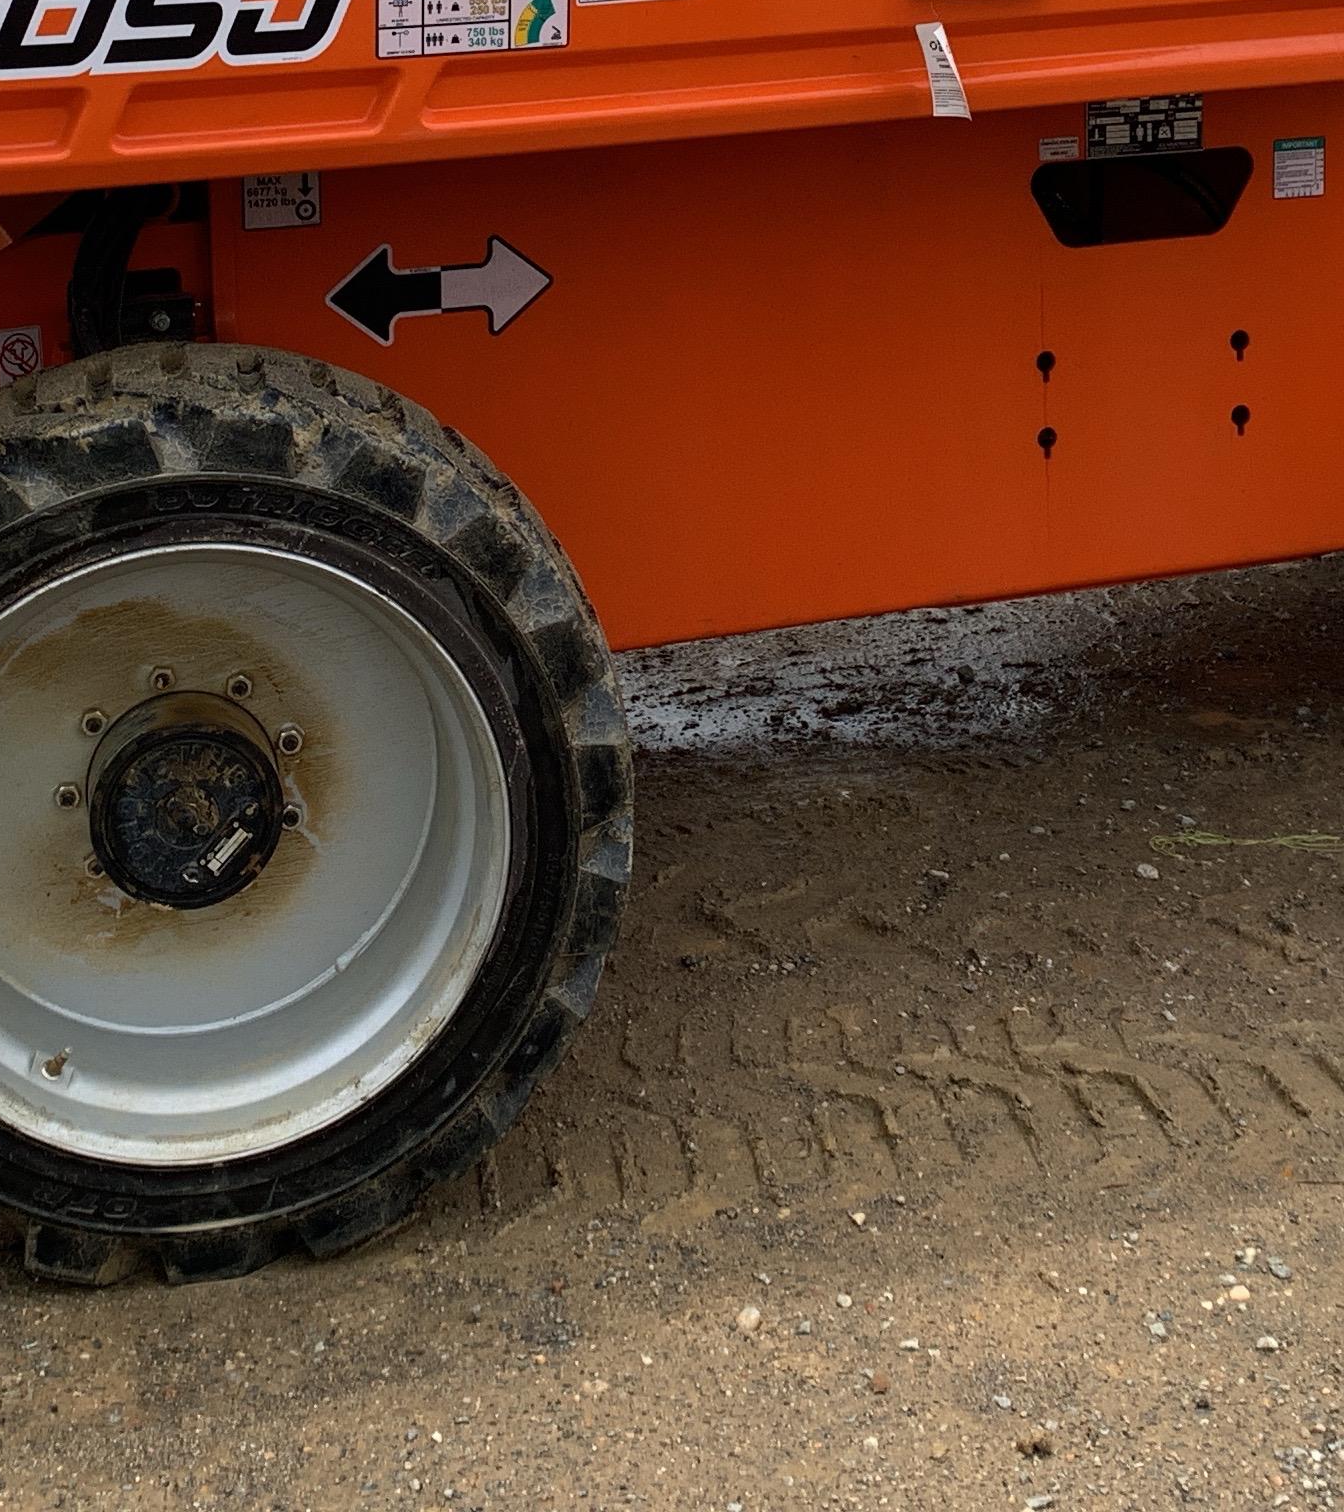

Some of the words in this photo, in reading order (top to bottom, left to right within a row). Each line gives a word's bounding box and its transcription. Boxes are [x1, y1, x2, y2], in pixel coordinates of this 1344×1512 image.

[470, 6, 489, 15] 250
[493, 5, 506, 16] kg
[467, 27, 485, 37] 750
[488, 27, 505, 36] lbs
[468, 38, 486, 47] 340
[490, 37, 503, 47] kg
[256, 175, 282, 186] MAX
[247, 187, 271, 197] 6677
[275, 186, 287, 196] kg
[248, 198, 278, 208] 14720
[281, 198, 296, 206] lbs
